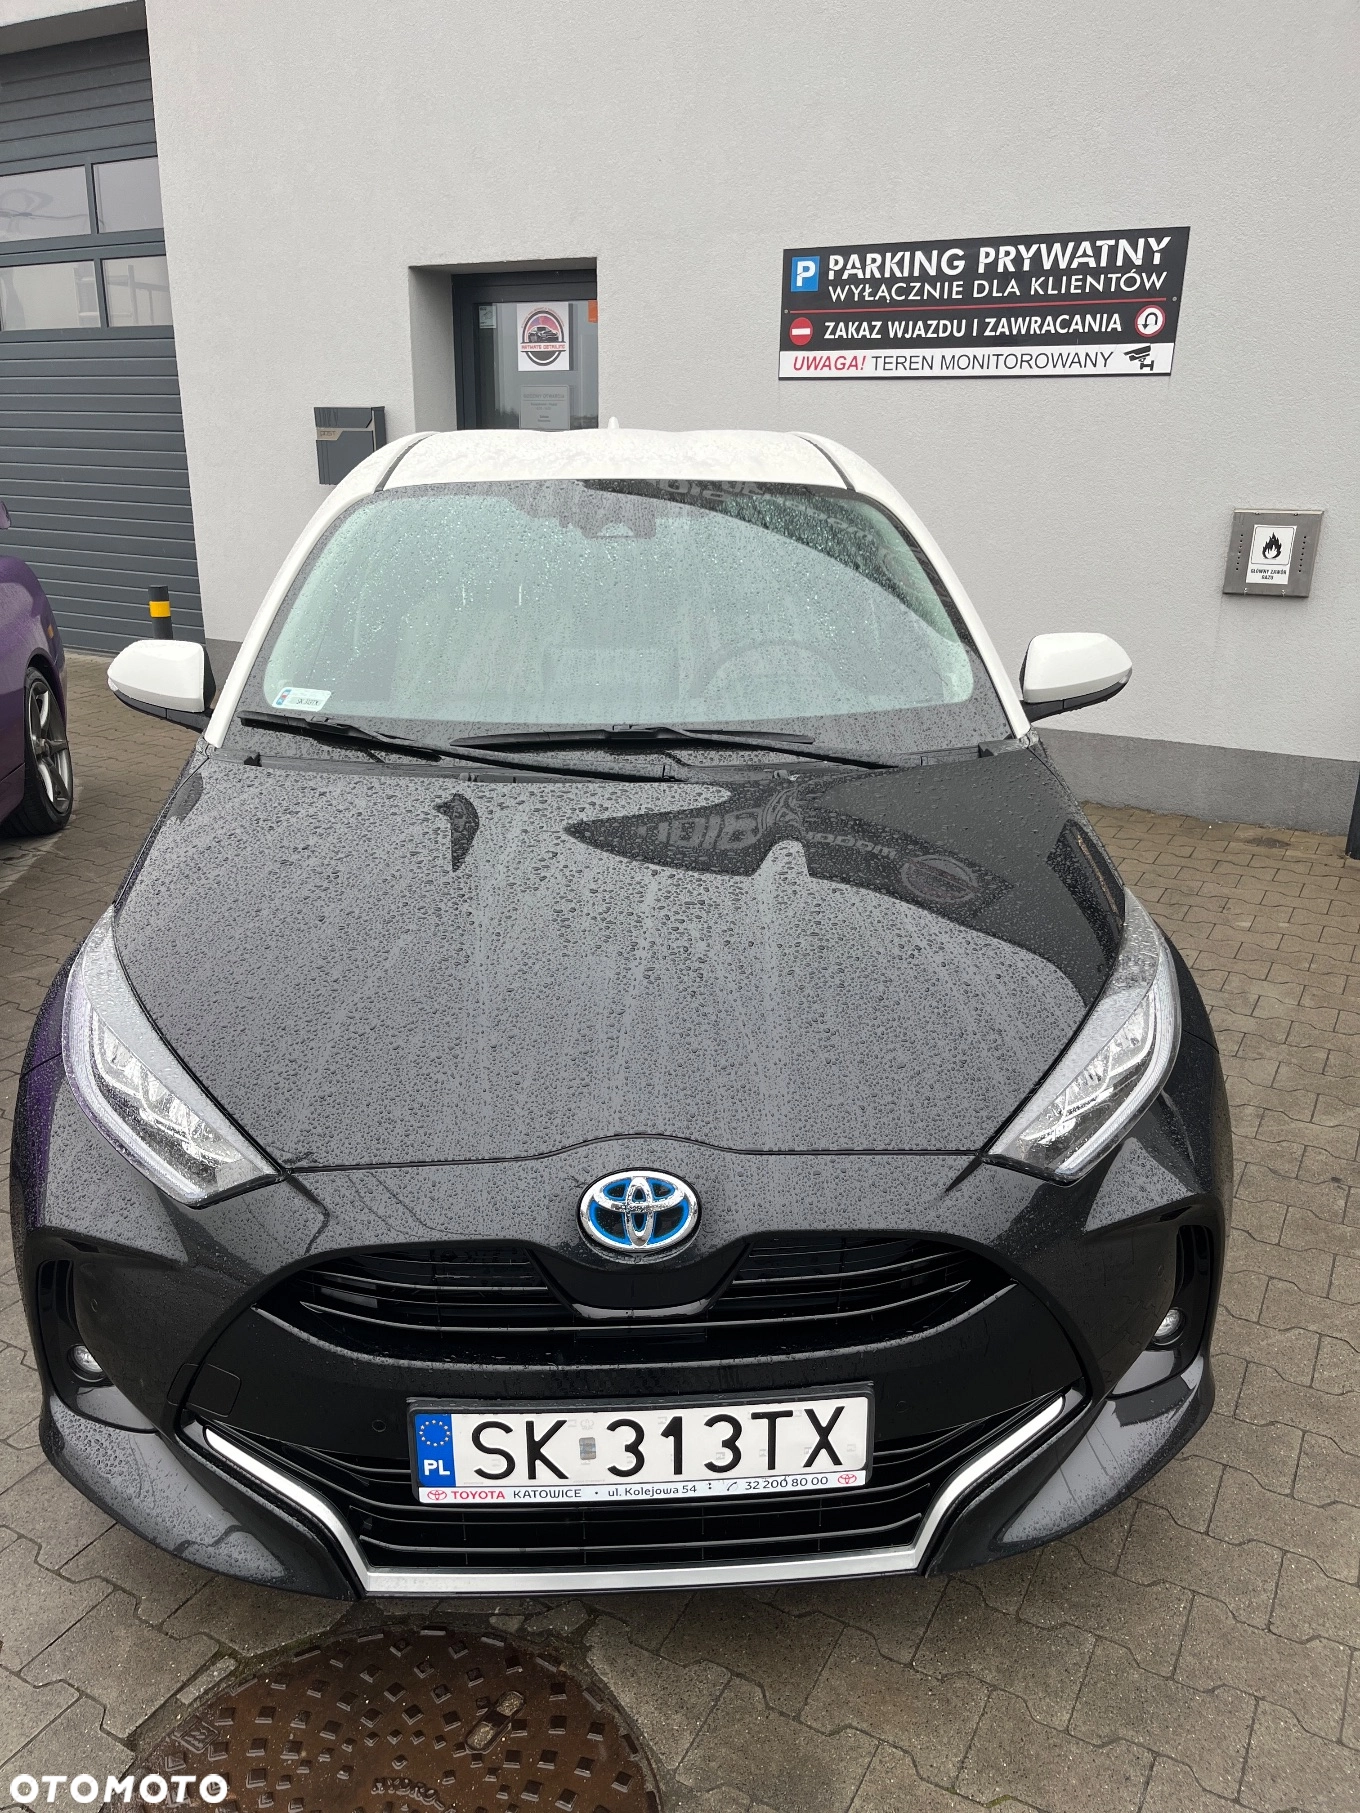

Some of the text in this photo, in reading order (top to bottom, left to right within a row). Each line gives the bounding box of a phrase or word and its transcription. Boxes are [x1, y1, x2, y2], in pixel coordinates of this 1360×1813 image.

[828, 236, 1172, 280] PARKING PRYWATNY
[796, 260, 816, 287] P
[828, 269, 1168, 303] WYŁĄCZNIE DLA KLIENTÓW
[824, 313, 1122, 339] ZAKAZ WJAZDU I ZAWRACANIA
[793, 351, 1114, 371] UWAGA! TEREN MONITOROWANY
[471, 1405, 846, 1480] SK 313TX
[423, 1459, 451, 1476] PL
[450, 1476, 829, 1500] TOYOTA KATOWICE ul. Kolejowa 54 32 200 80 00
